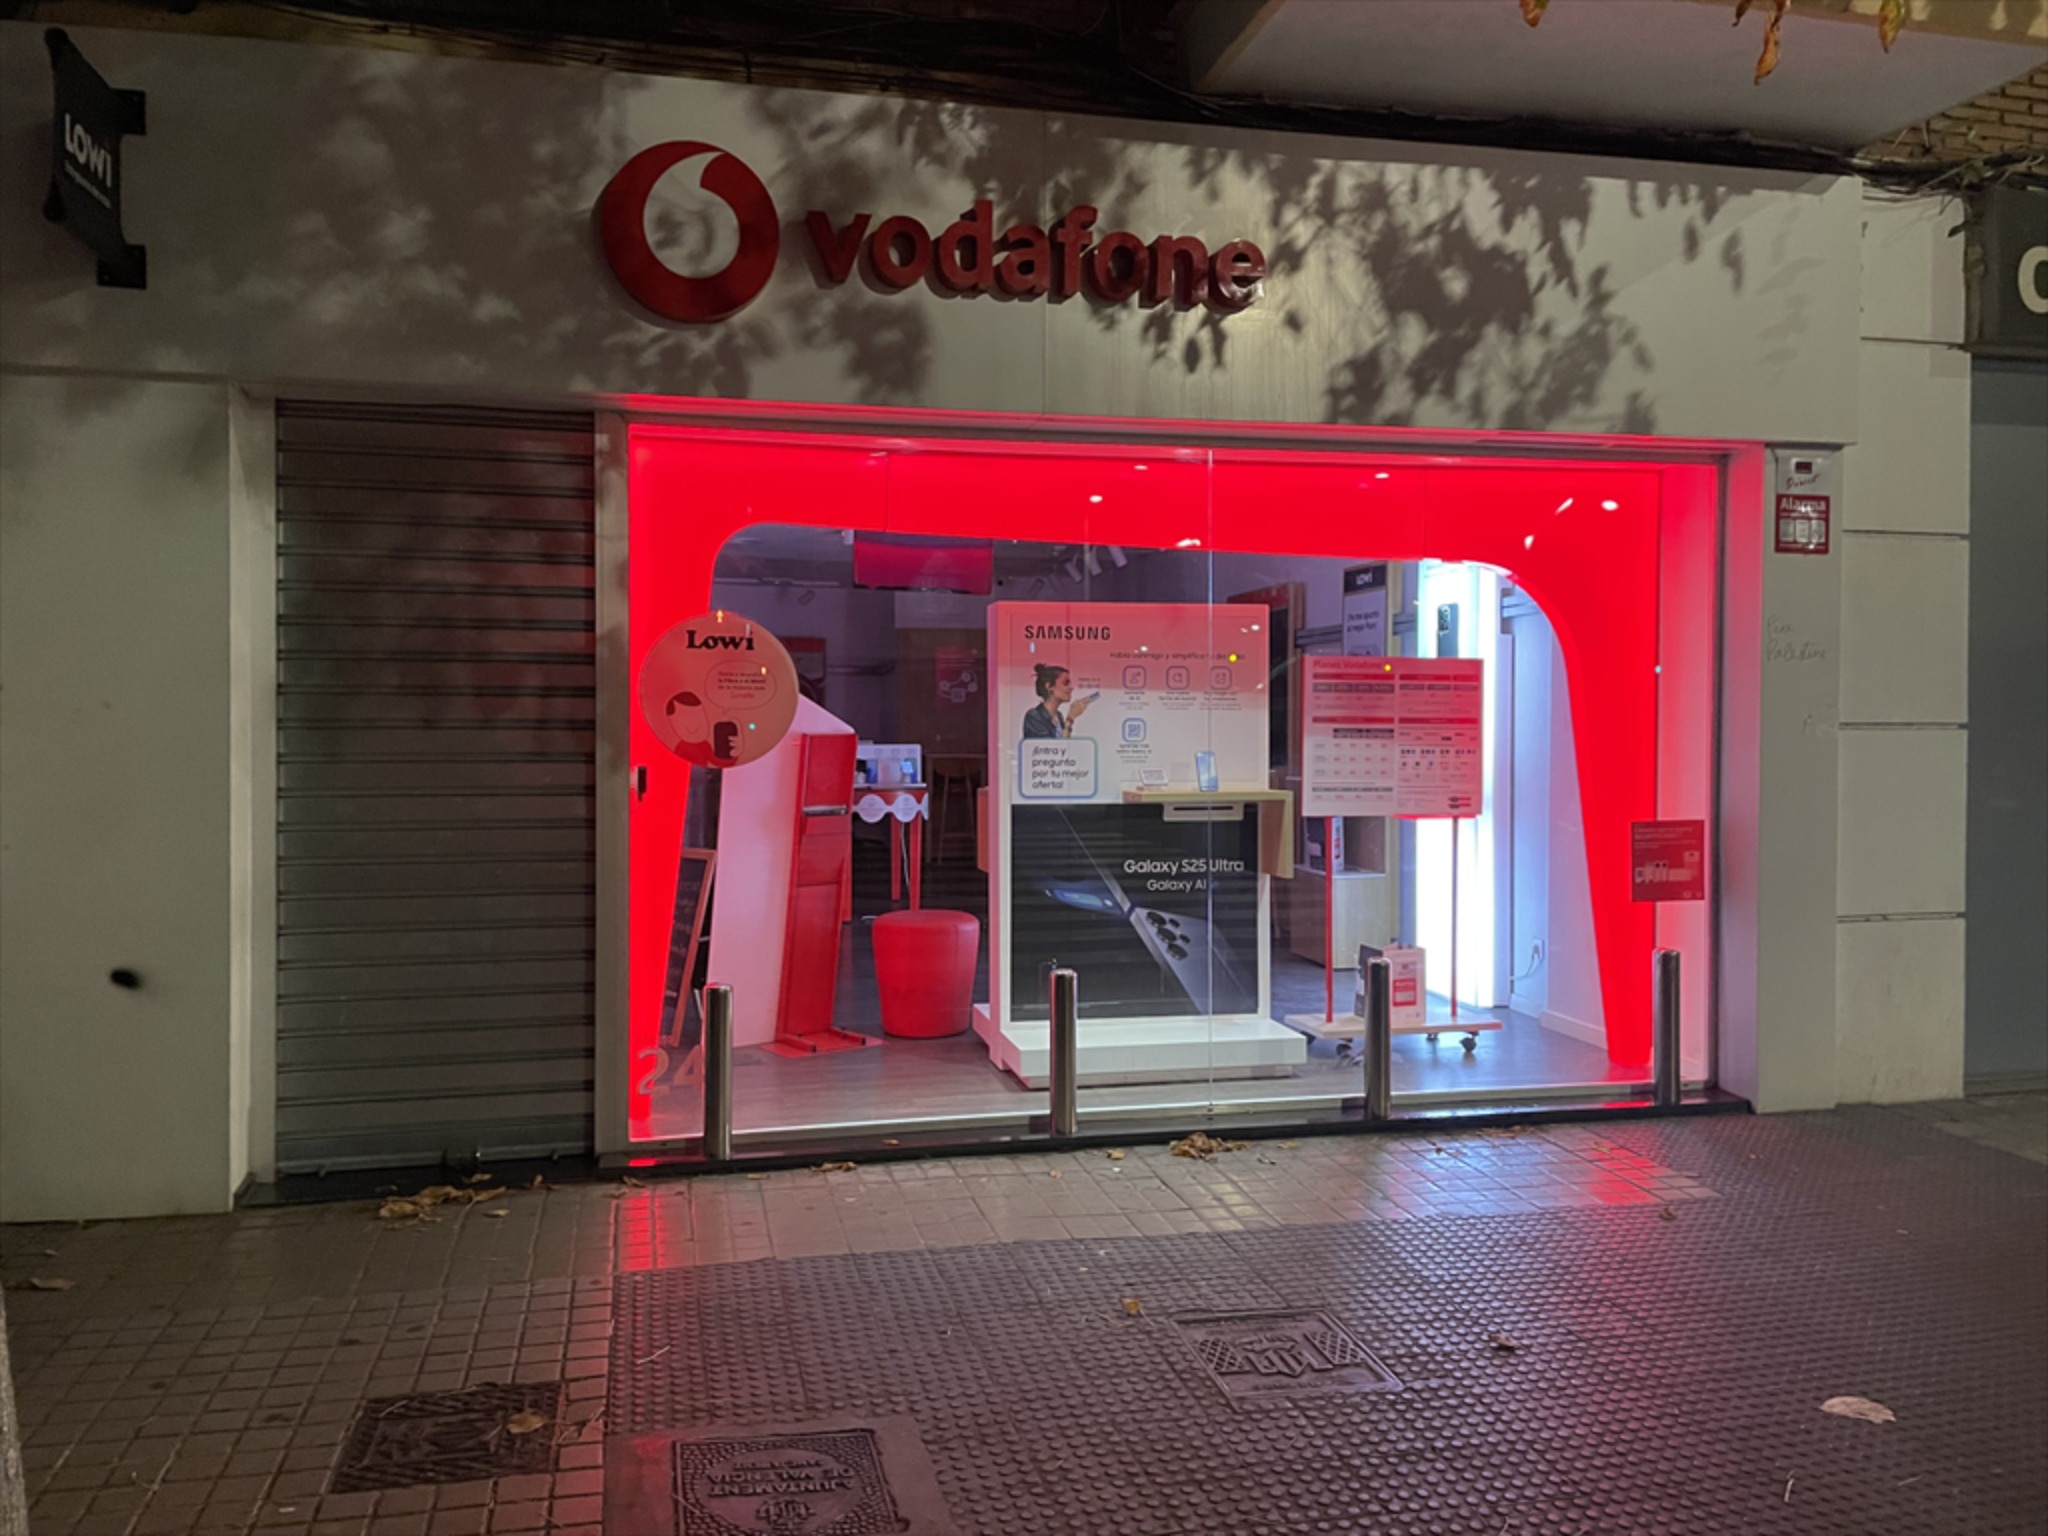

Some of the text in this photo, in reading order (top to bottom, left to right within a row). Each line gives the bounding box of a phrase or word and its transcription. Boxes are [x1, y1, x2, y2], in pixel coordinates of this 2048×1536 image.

[805, 200, 1267, 313] vodafone
[685, 630, 755, 650] Lowi
[1024, 625, 1111, 641] SAMSUNG
[1060, 748, 1066, 757] y
[1031, 769, 1089, 780] por tu mejor
[1123, 859, 1244, 875] Galaxy S25 Ultra
[1146, 879, 1207, 892] Galaxy AI
